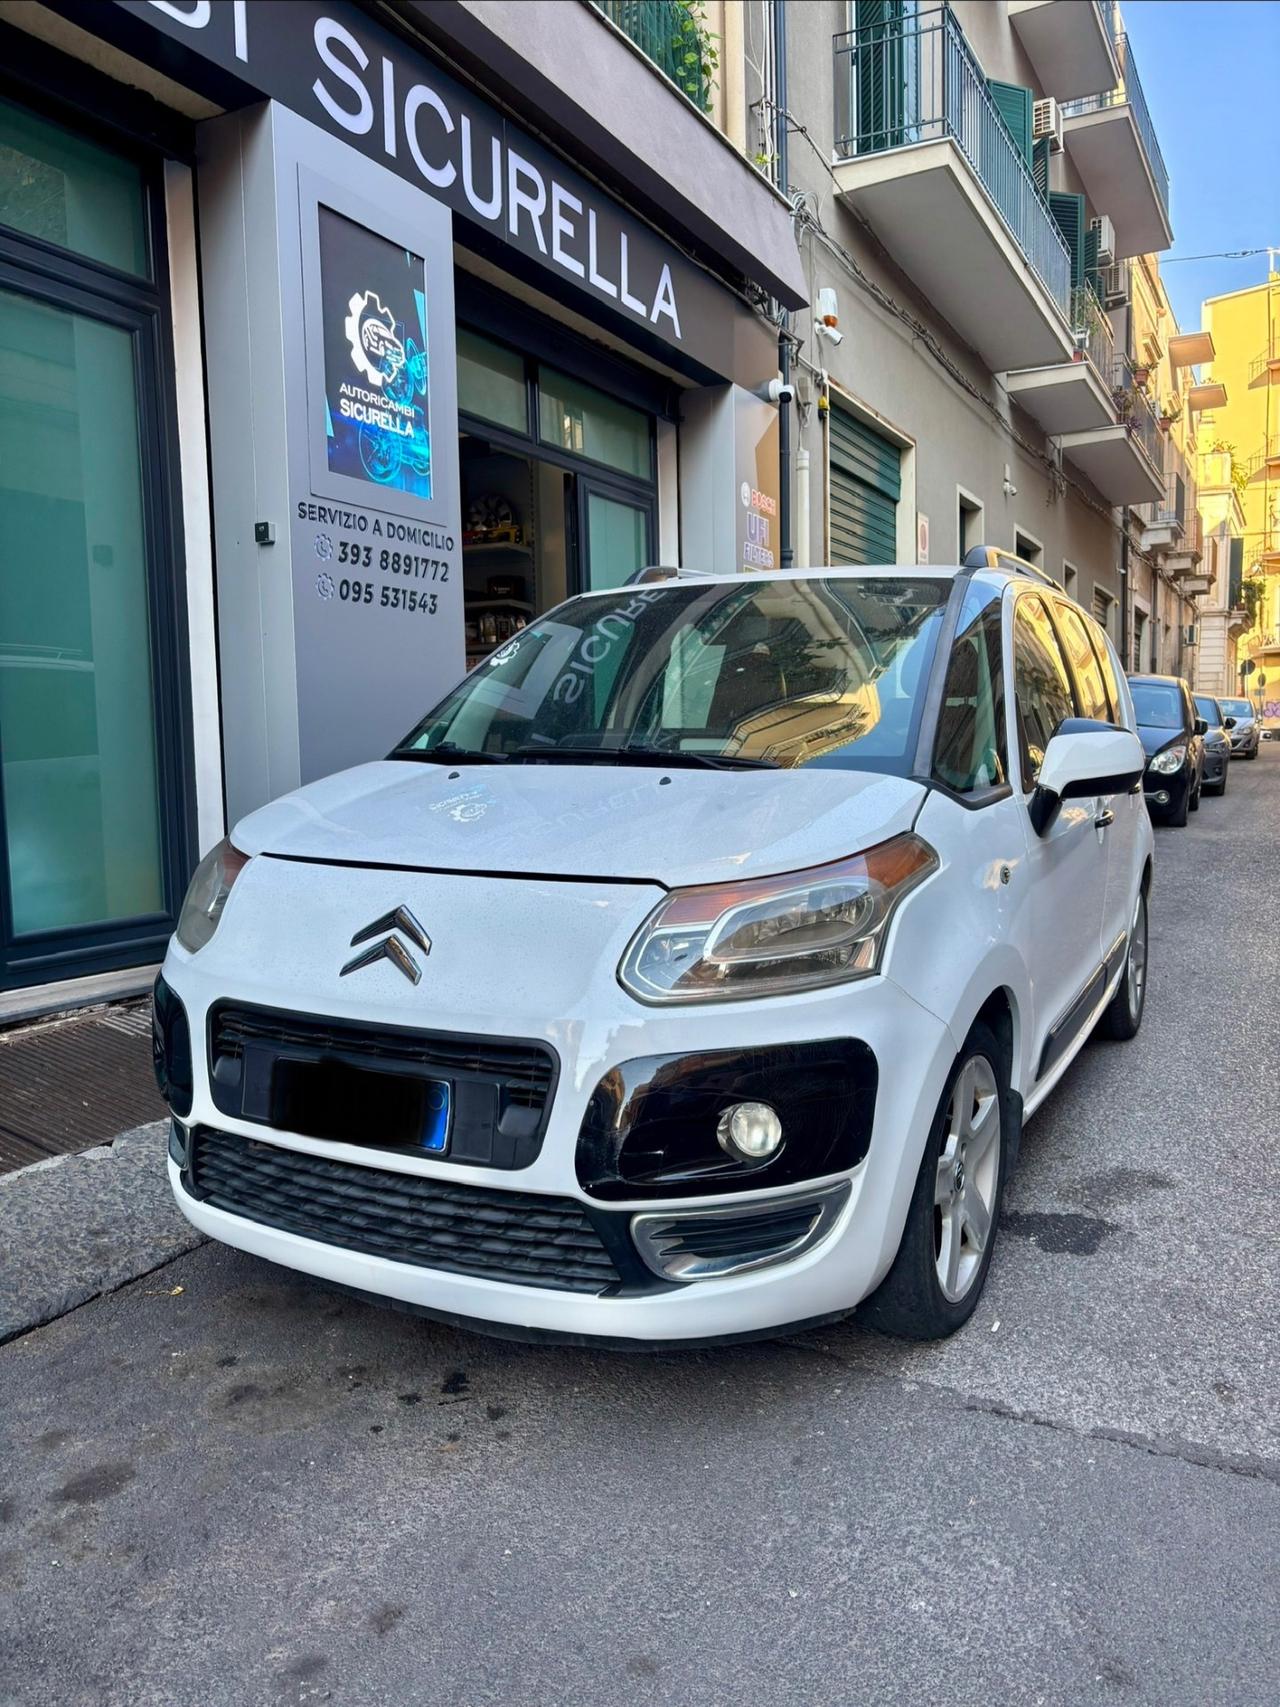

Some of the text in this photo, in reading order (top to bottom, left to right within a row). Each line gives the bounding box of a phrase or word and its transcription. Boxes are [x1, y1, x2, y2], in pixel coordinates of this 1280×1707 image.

[311, 15, 683, 340] SICURELLA
[339, 382, 415, 419] AUTORICAMBI
[339, 399, 415, 438] SICURELLA
[751, 488, 777, 517] BOSCH
[297, 501, 455, 552] SERVIZIO A DOMICILIO
[746, 511, 770, 548] UFI
[338, 541, 450, 583] 393 8891772
[339, 578, 439, 616] 095 531543
